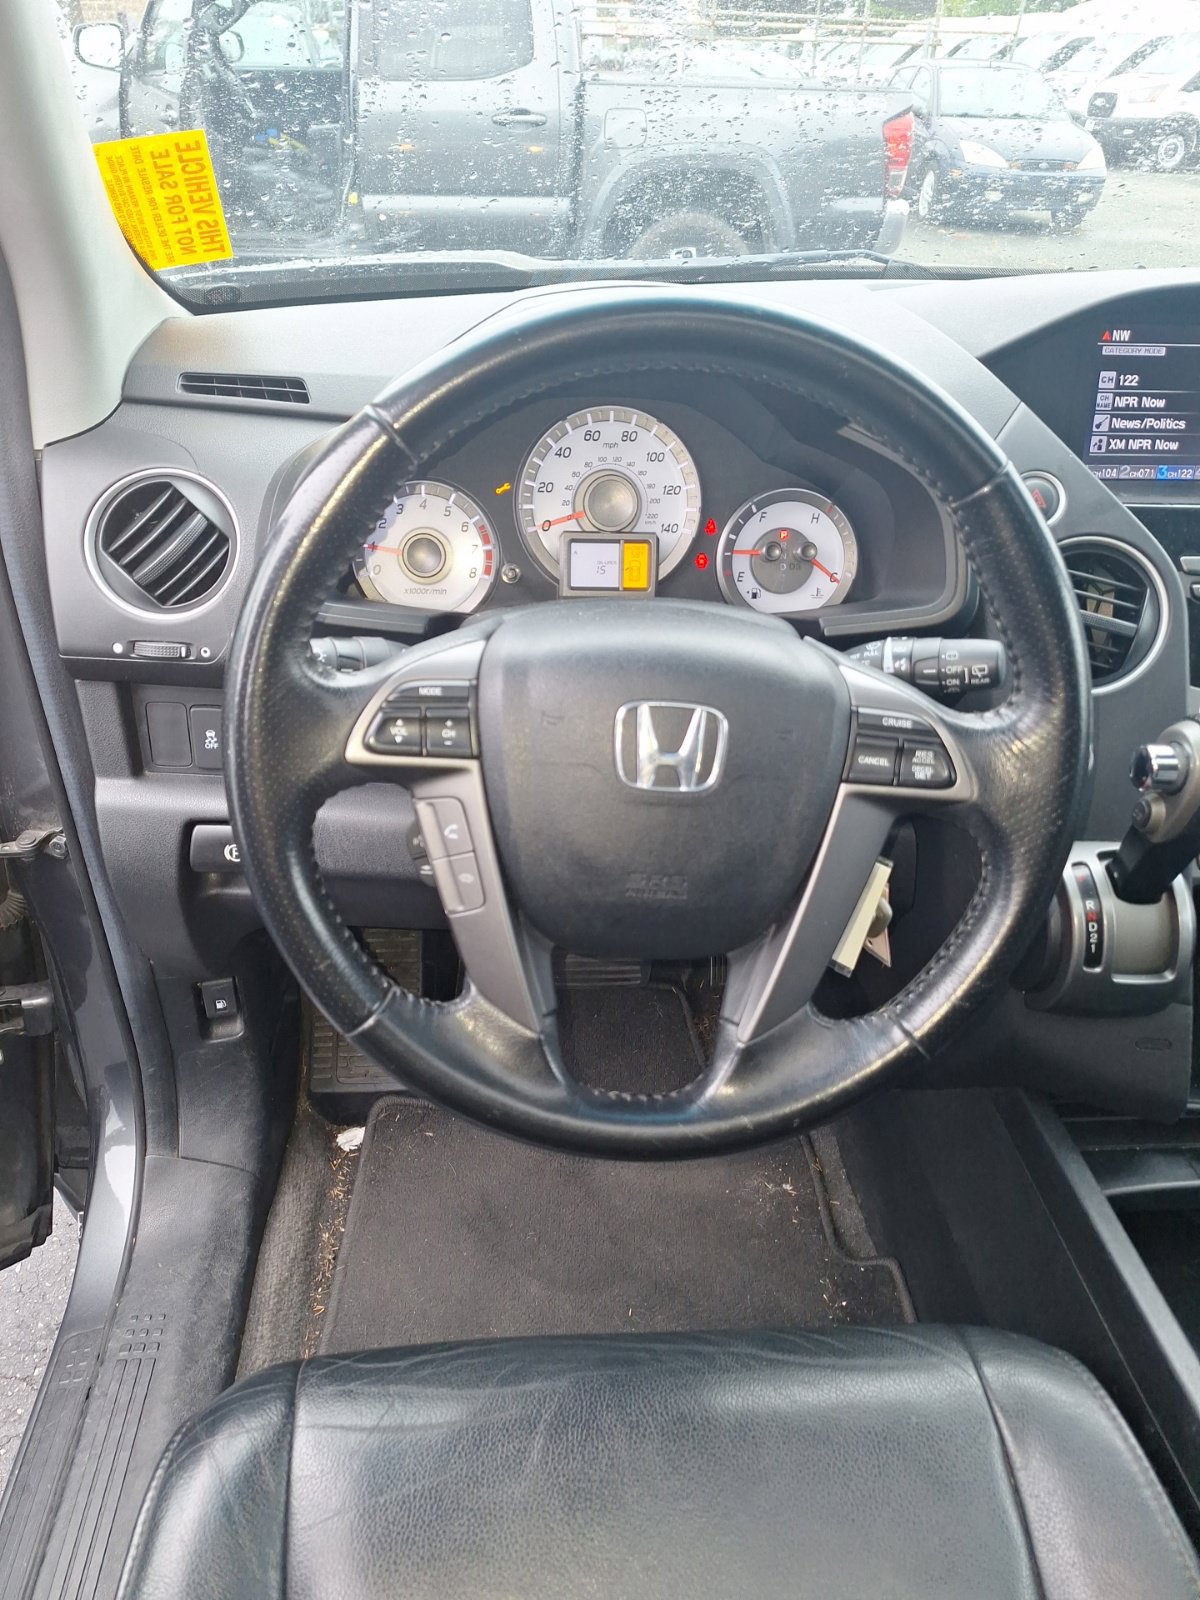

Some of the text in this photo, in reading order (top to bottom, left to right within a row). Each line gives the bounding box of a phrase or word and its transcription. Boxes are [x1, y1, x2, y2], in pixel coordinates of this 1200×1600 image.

[1112, 330, 1131, 341] NW
[1144, 347, 1164, 355] MODE
[1101, 375, 1139, 386] CH 122
[1114, 396, 1165, 408] NPR Now
[1111, 418, 1186, 430] News/Politics
[583, 430, 601, 442] 60
[621, 430, 638, 442] 80
[602, 441, 619, 449] mph
[1108, 438, 1179, 451] XM NPR Now
[555, 447, 571, 458] 40
[646, 452, 665, 463] 100
[1120, 465, 1130, 478] 2
[1158, 465, 1168, 479] 3
[538, 482, 554, 493] 20
[662, 485, 681, 495] 120
[396, 503, 404, 515] 3
[418, 499, 428, 511] 4
[444, 505, 452, 517] 5
[378, 517, 387, 529] 2
[759, 512, 767, 523] F
[811, 513, 820, 524] H
[460, 521, 469, 532] 6
[541, 520, 551, 532] 0
[660, 523, 679, 533] 140
[471, 545, 479, 555] 7
[372, 564, 381, 576] 0
[469, 568, 478, 579] 8
[737, 571, 745, 582] E
[829, 572, 838, 583] C
[404, 587, 447, 596] x1000r/min
[946, 666, 963, 674] OFF
[946, 678, 960, 686] ON
[970, 677, 990, 685] REAR
[882, 717, 913, 729] CRUISE
[915, 750, 934, 758] RES
[857, 755, 891, 767] CANCEL
[1085, 900, 1095, 911] R
[1088, 922, 1098, 932] D
[1089, 933, 1098, 943] 2
